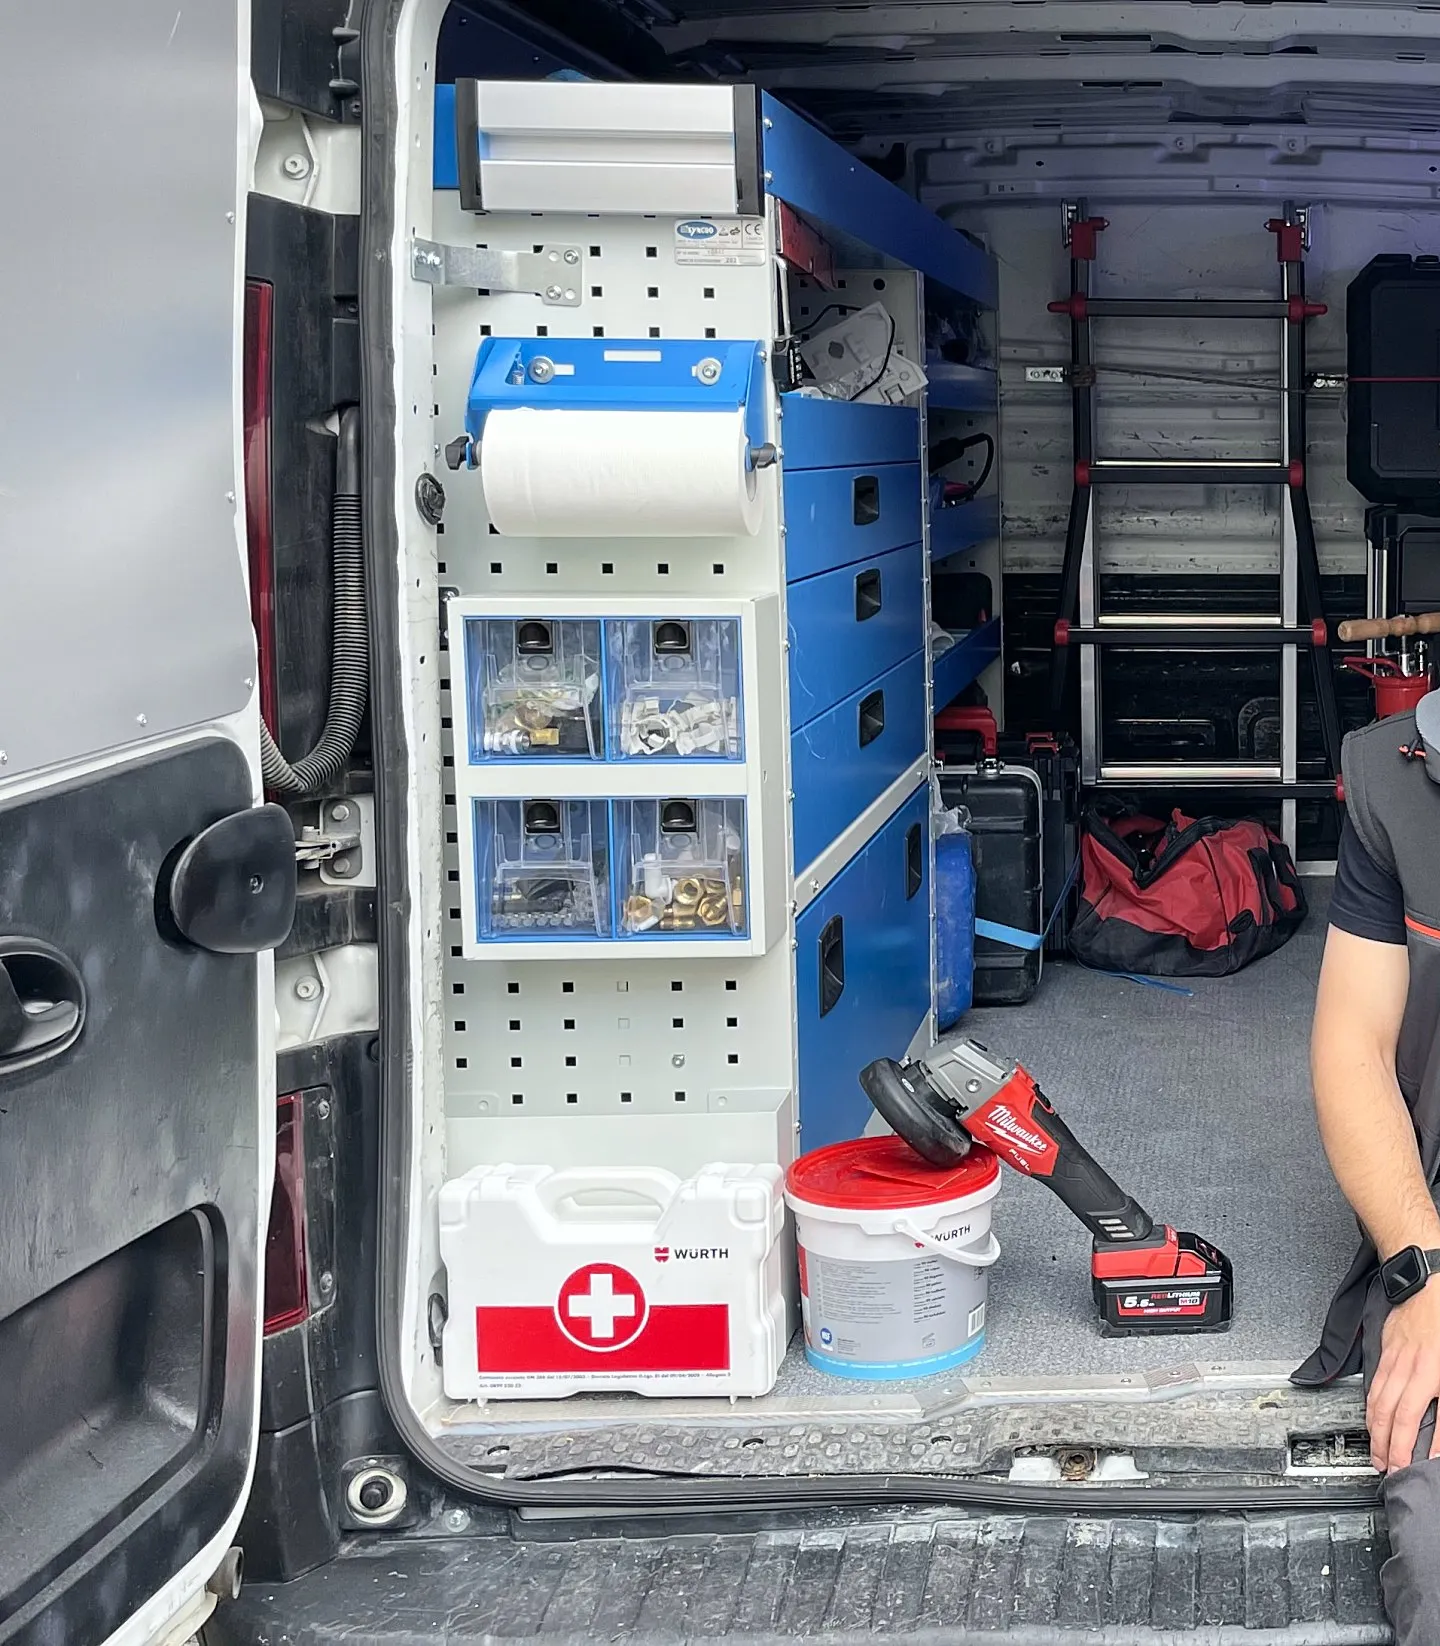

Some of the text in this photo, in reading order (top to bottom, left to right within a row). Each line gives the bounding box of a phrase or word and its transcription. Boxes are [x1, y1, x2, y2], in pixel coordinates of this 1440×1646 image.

[988, 1104, 1048, 1152] Milwaukee
[1008, 1148, 1031, 1172] FUEL
[674, 1247, 729, 1260] WÜRTH
